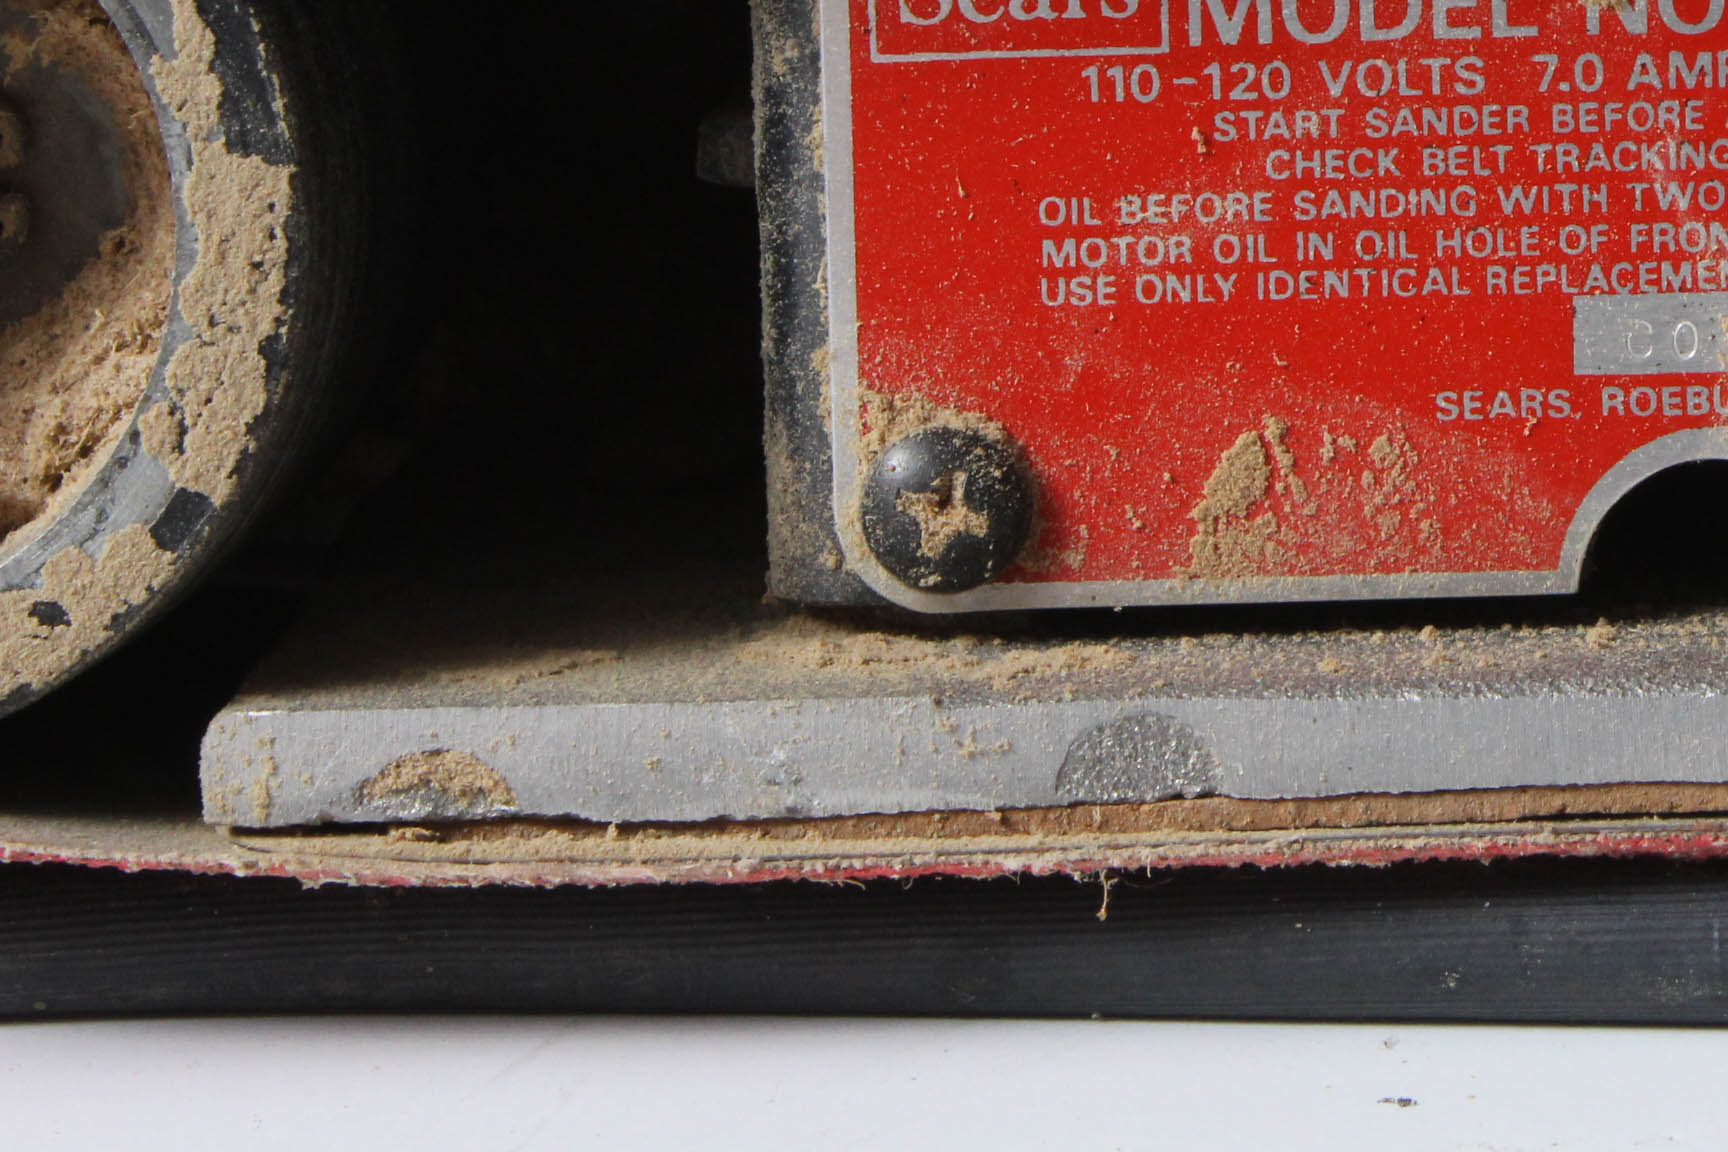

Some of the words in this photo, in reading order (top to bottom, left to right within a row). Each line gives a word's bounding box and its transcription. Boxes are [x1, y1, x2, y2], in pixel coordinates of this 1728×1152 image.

[1319, 56, 1485, 98] VOLTS
[1532, 53, 1604, 92] 7.0
[1214, 109, 1345, 141] START
[1366, 105, 1529, 138] SANDER
[1553, 100, 1704, 132] BEFORE
[1266, 148, 1400, 179] CHECK
[1423, 145, 1512, 176] BELT
[1040, 197, 1102, 226] OIL
[1121, 192, 1272, 223] BEFORE
[1295, 185, 1476, 220] SANDING
[1498, 184, 1608, 214] WITH
[1627, 174, 1725, 211] TWO
[1043, 234, 1192, 268] MOTOR
[1213, 234, 1277, 263] OIL
[1297, 232, 1333, 260] IN
[1356, 230, 1418, 260] OIL
[1437, 226, 1547, 258] HOLE
[1560, 224, 1608, 254] OF
[1042, 274, 1116, 306] USE
[1136, 274, 1237, 304] ONLY
[1258, 267, 1470, 299] IDENTICAL
